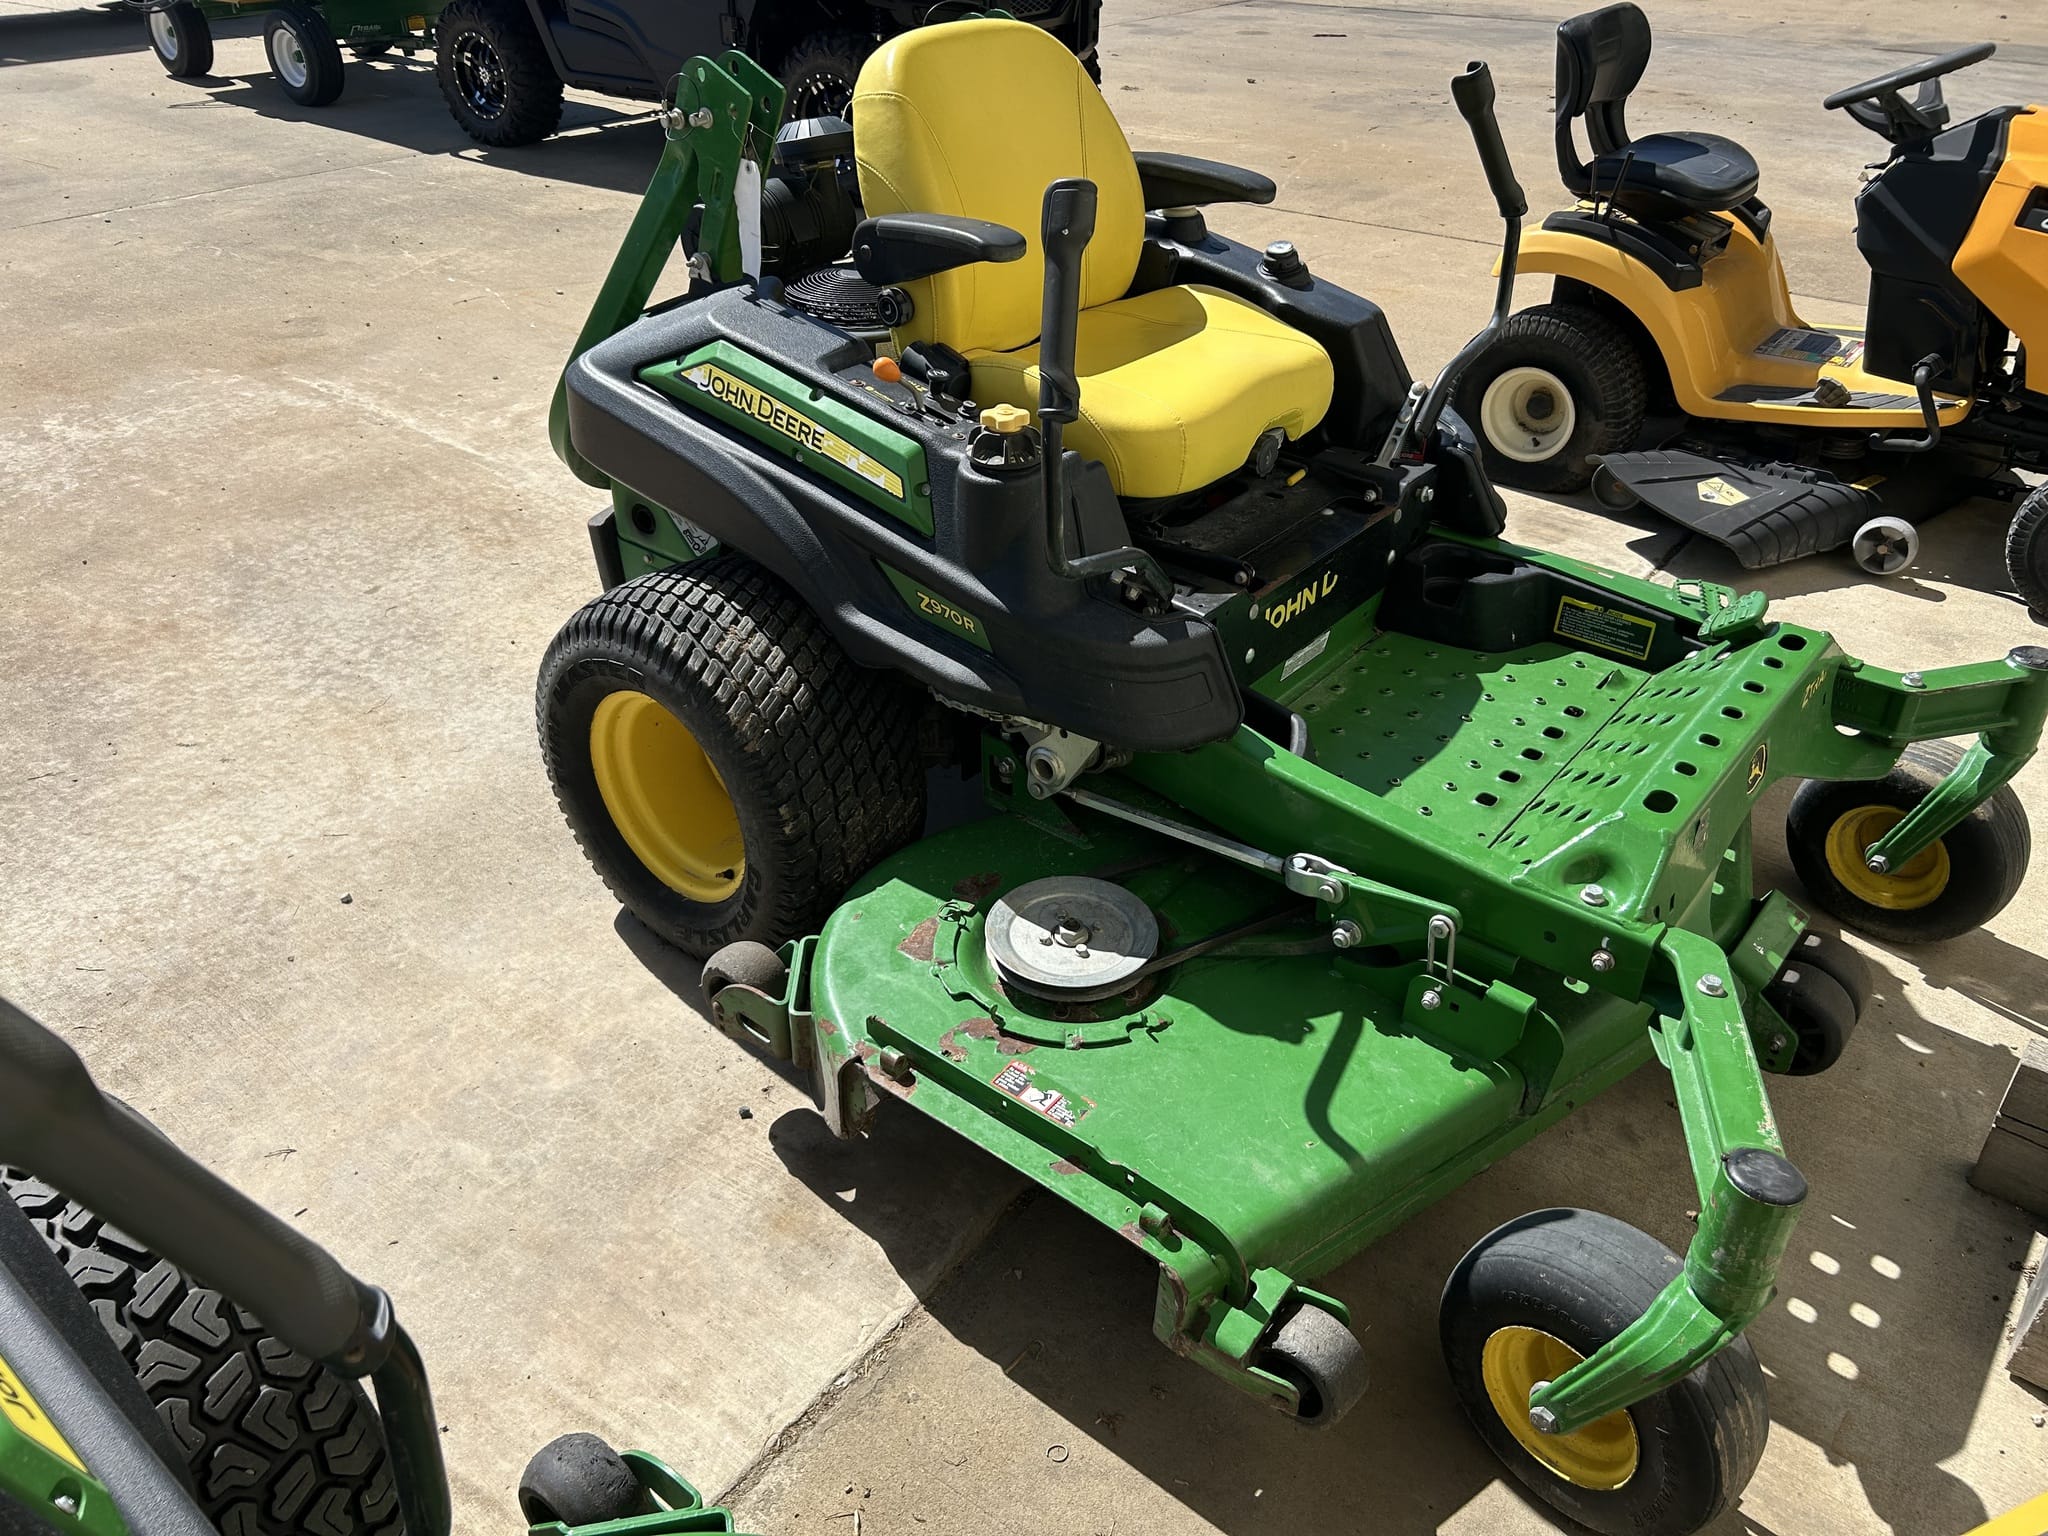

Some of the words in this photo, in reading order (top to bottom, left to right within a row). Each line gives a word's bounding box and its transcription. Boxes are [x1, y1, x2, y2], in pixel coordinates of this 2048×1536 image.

[700, 368, 755, 413] JOHN
[757, 394, 825, 451] DEERE
[917, 591, 976, 634] Z970R
